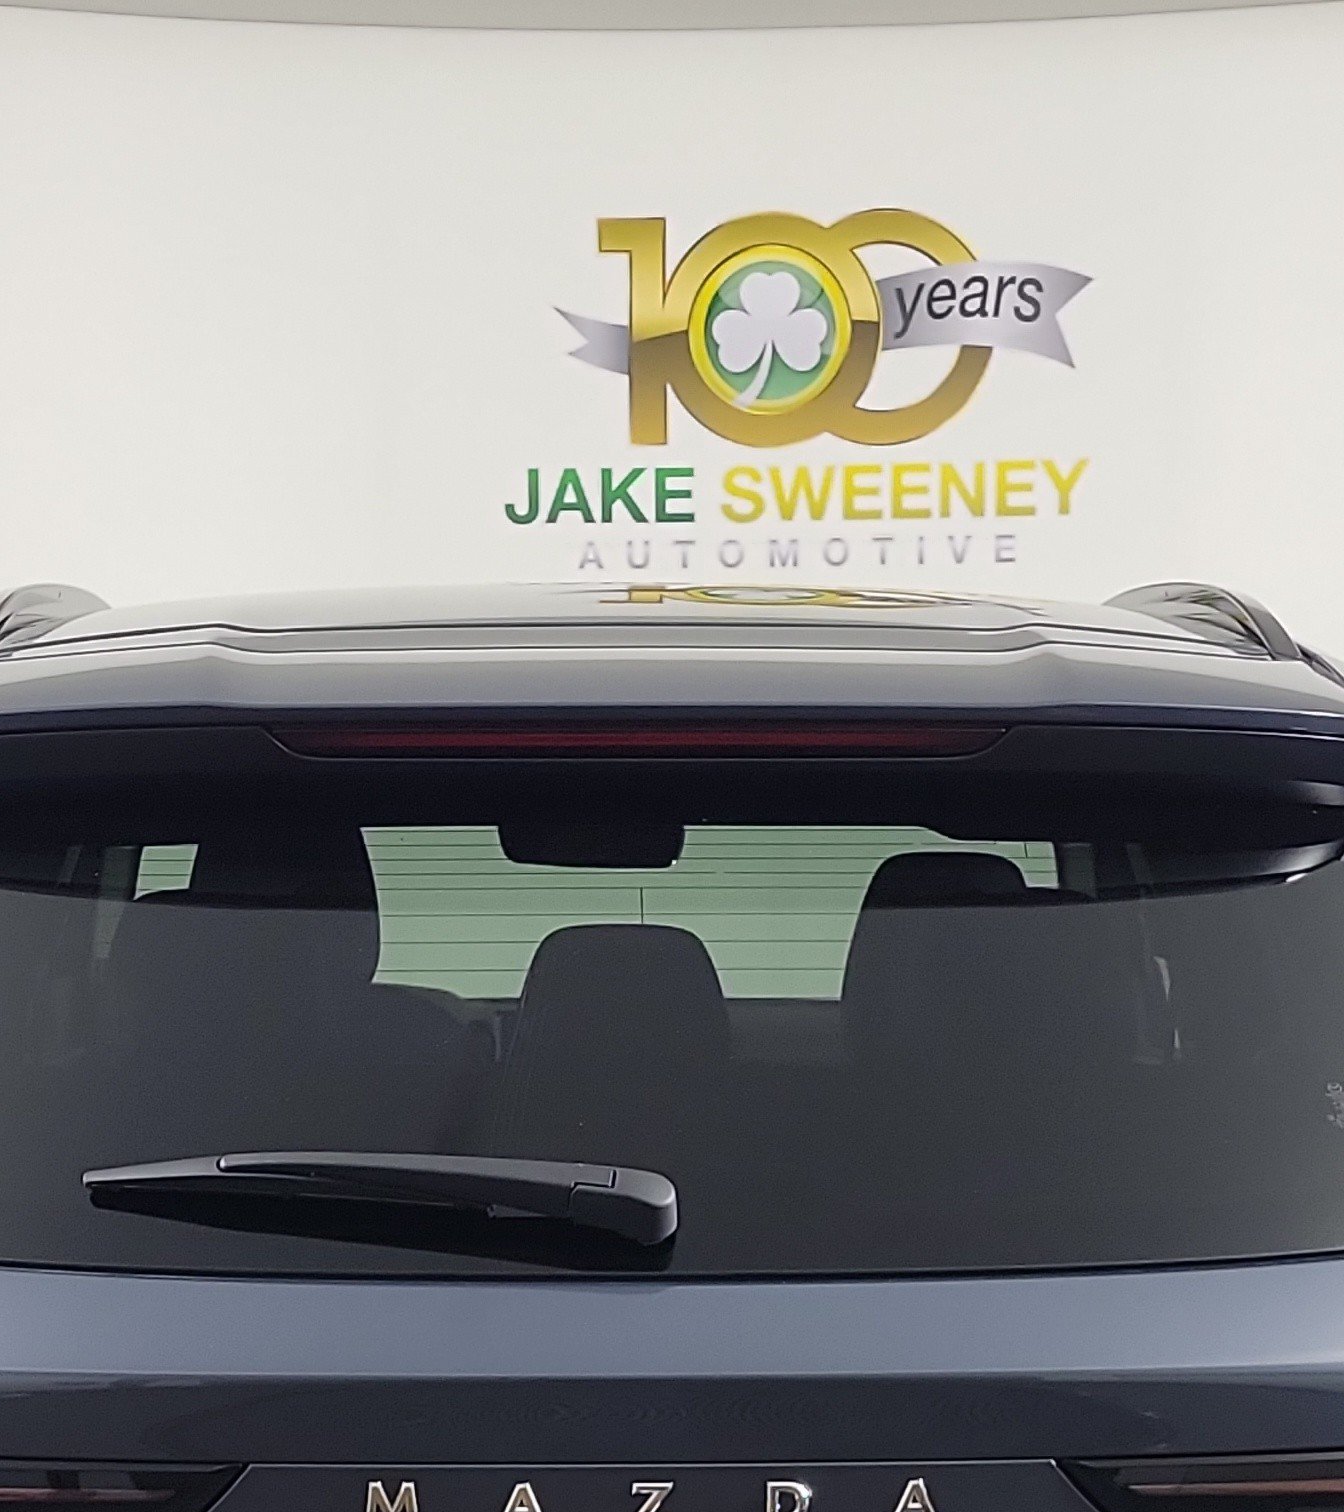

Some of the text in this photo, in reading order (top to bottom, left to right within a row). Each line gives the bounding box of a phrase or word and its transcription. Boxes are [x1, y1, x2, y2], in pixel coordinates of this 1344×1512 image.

[597, 207, 992, 448] 100
[894, 273, 1045, 340] years
[505, 458, 1090, 525] JAKE SWEENEY
[578, 534, 1018, 571] AUTOMOTIVE
